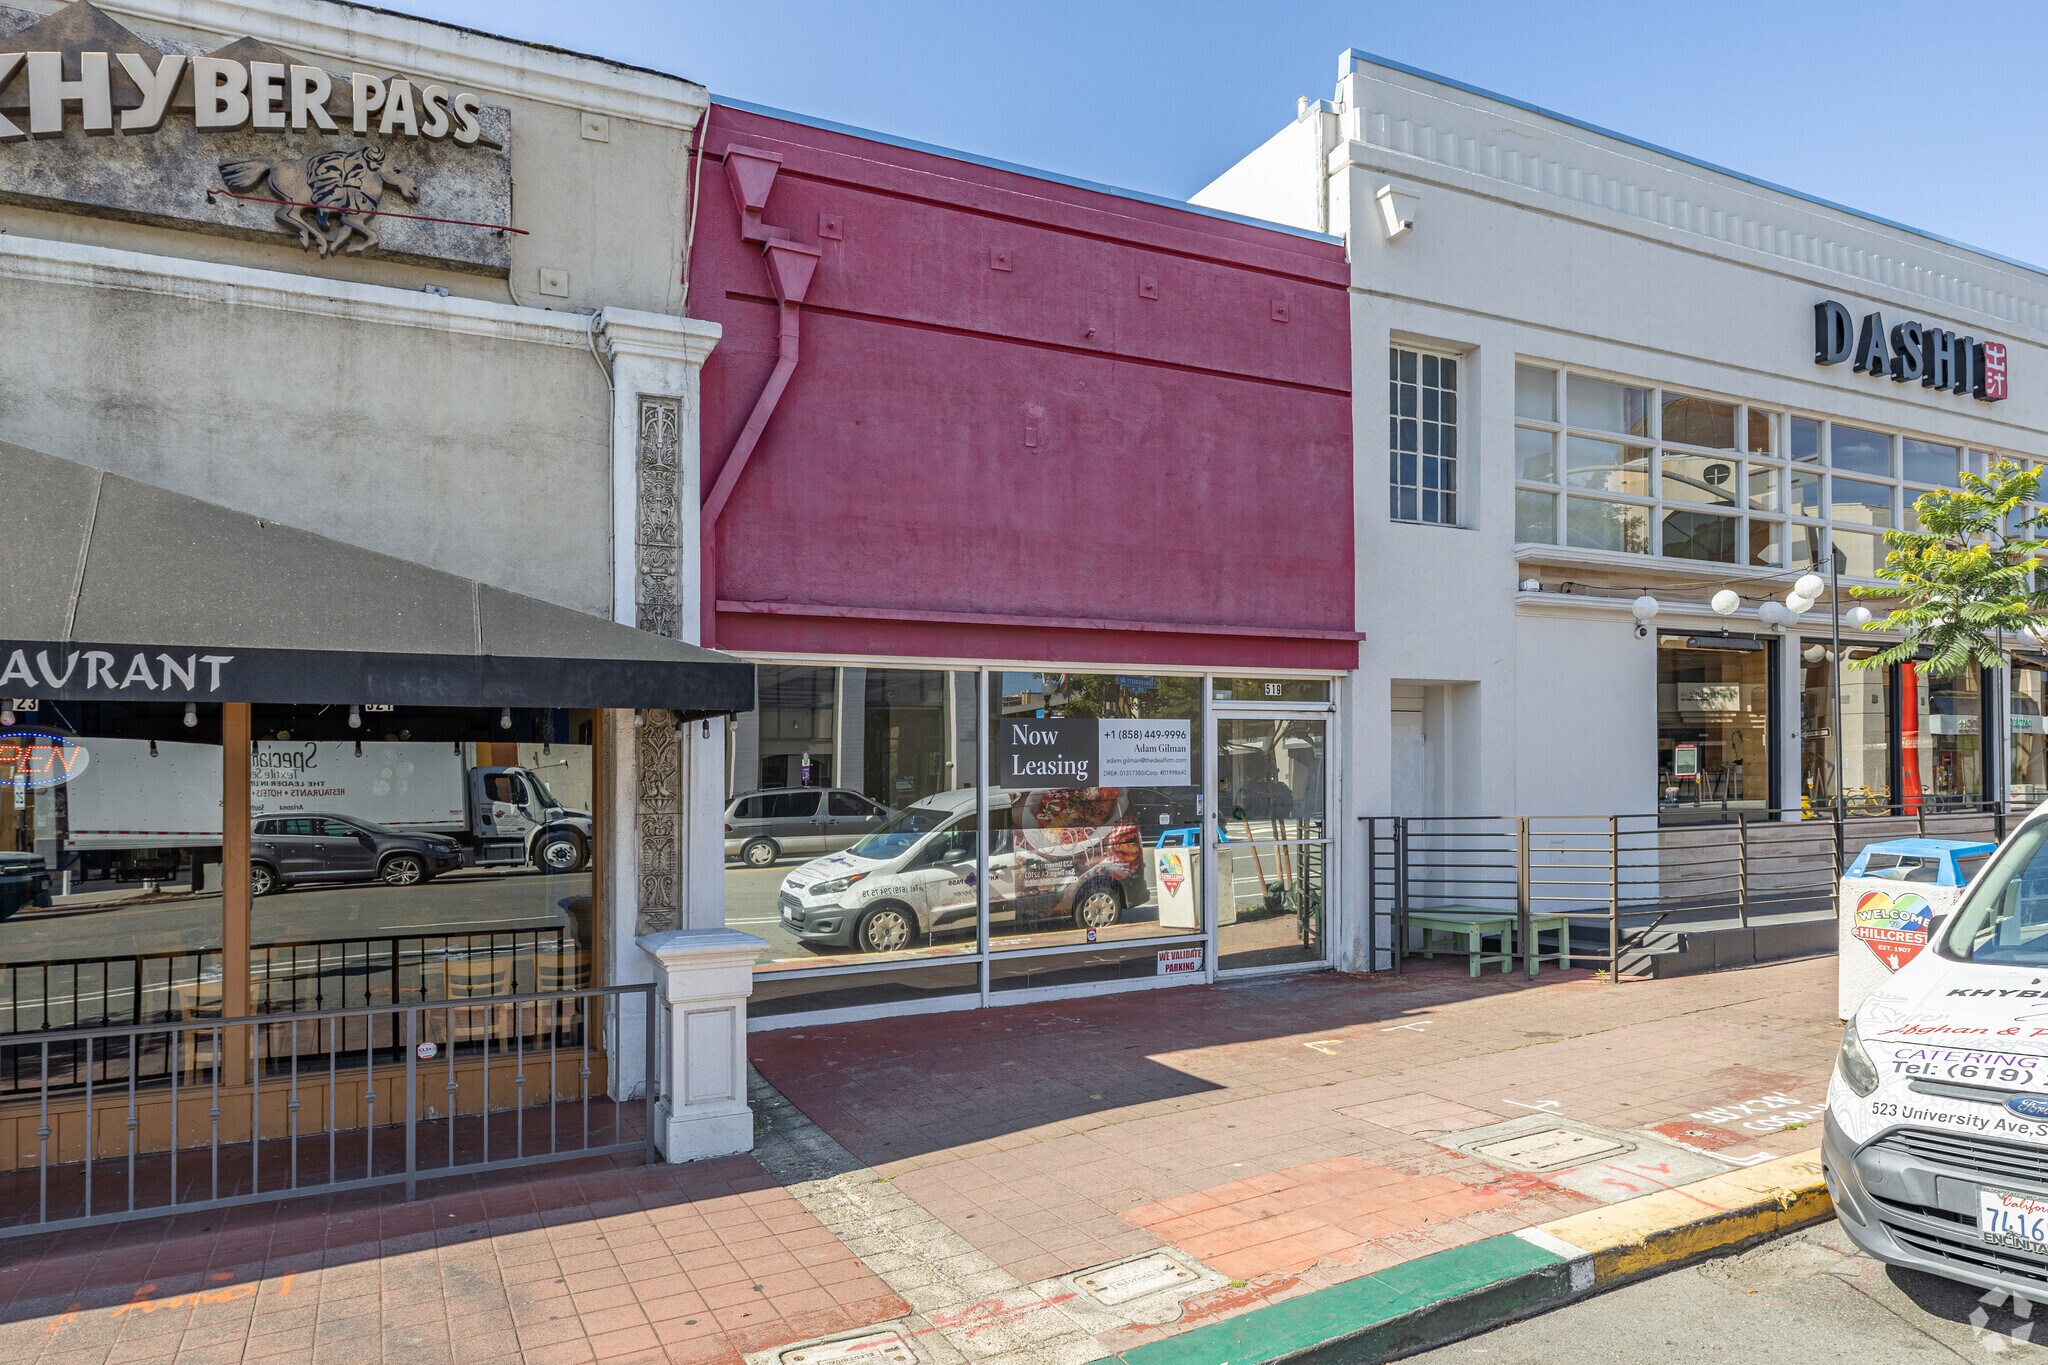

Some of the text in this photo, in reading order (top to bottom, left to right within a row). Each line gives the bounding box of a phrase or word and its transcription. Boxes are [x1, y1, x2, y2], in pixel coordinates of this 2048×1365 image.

[352, 72, 481, 149] PASS
[1814, 300, 1974, 395] DASHI
[0, 648, 235, 693] AURANT
[1266, 684, 1281, 694] 519
[1012, 724, 1058, 746] Now
[1104, 730, 1186, 740] +1 (858) 449-9996
[1134, 744, 1186, 753] Adam Gilman
[1012, 754, 1088, 781] Leasing
[1106, 758, 1187, 766] adam.gilman@thedealfirm.com
[1857, 908, 1930, 927] WELCOME
[1860, 928, 1928, 944] HILLCREST
[1159, 948, 1202, 962] WE VALIDATE
[1878, 944, 1892, 952] EST.
[1166, 962, 1194, 972] PARKING
[1877, 1024, 1989, 1036] Afghan
[1996, 1027, 2021, 1036] &
[1894, 1048, 2040, 1068] CATERING
[1892, 1060, 1938, 1075] Tel:
[1947, 1064, 2034, 1085] (619)
[1872, 1102, 1898, 1116] 523
[1902, 1106, 1990, 1130] University
